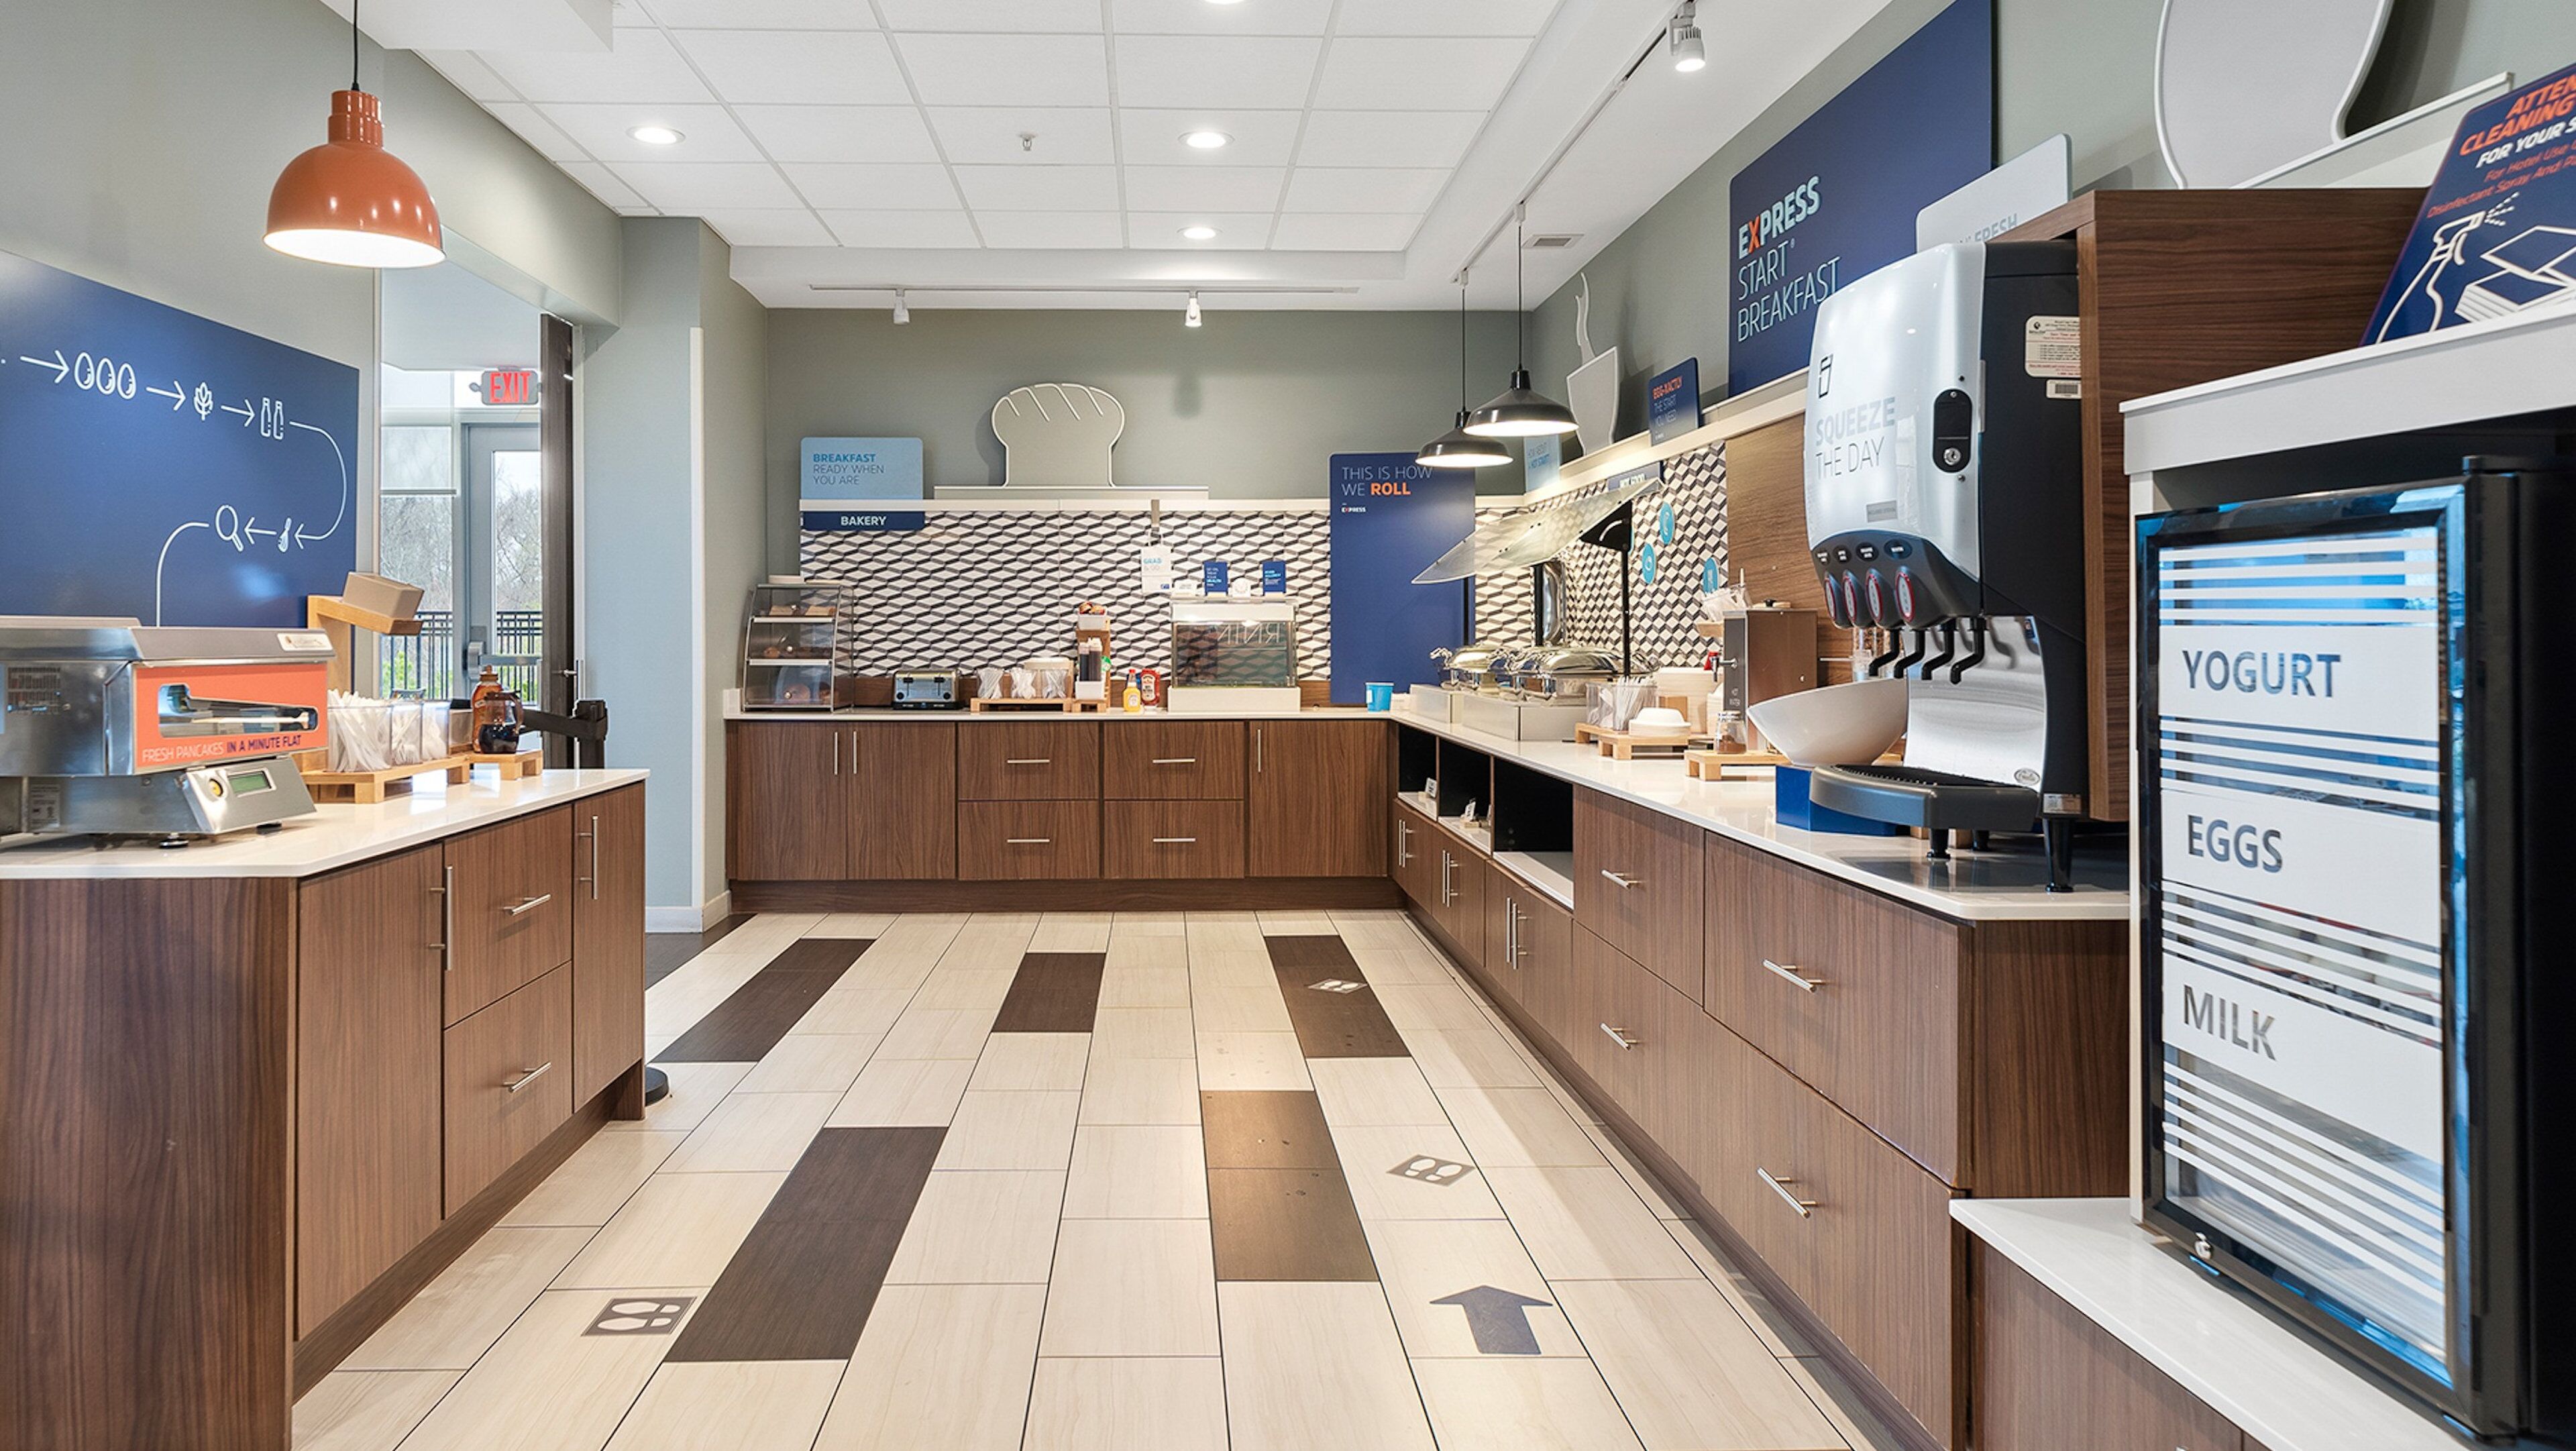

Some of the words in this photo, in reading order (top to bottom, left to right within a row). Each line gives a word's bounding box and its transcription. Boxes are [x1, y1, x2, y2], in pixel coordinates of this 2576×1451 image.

[2459, 94, 2576, 156] CLEANING
[2475, 142, 2514, 168] FOR
[2515, 121, 2566, 153] YOUR
[1738, 175, 1821, 260] EXPRESS
[1737, 256, 1841, 343] BREAKFAST
[490, 371, 531, 403] EXIT
[1815, 396, 1896, 447] SQUEEZE
[813, 453, 876, 462] BREAKFAST
[813, 465, 848, 474] READY
[851, 465, 884, 474] WHEN
[1342, 466, 1373, 480] THIS
[1378, 466, 1391, 480] IS
[1395, 466, 1433, 480] HOW
[1815, 447, 1842, 480] THE
[1849, 437, 1885, 473] DAY
[813, 476, 836, 484] YOU
[839, 476, 859, 484] ARE
[1342, 483, 1365, 496] WE
[1371, 482, 1411, 496] ROLL
[841, 516, 887, 526] BAKERY
[2182, 650, 2341, 698] YOGURT
[142, 747, 174, 763] FRESH
[176, 742, 224, 759] PANCAKES
[227, 742, 237, 753] IN
[239, 741, 246, 752] A
[248, 737, 280, 751] MINUTE
[283, 735, 301, 747] FLAT
[2188, 814, 2284, 873] EGGS
[2184, 984, 2276, 1061] MILK
